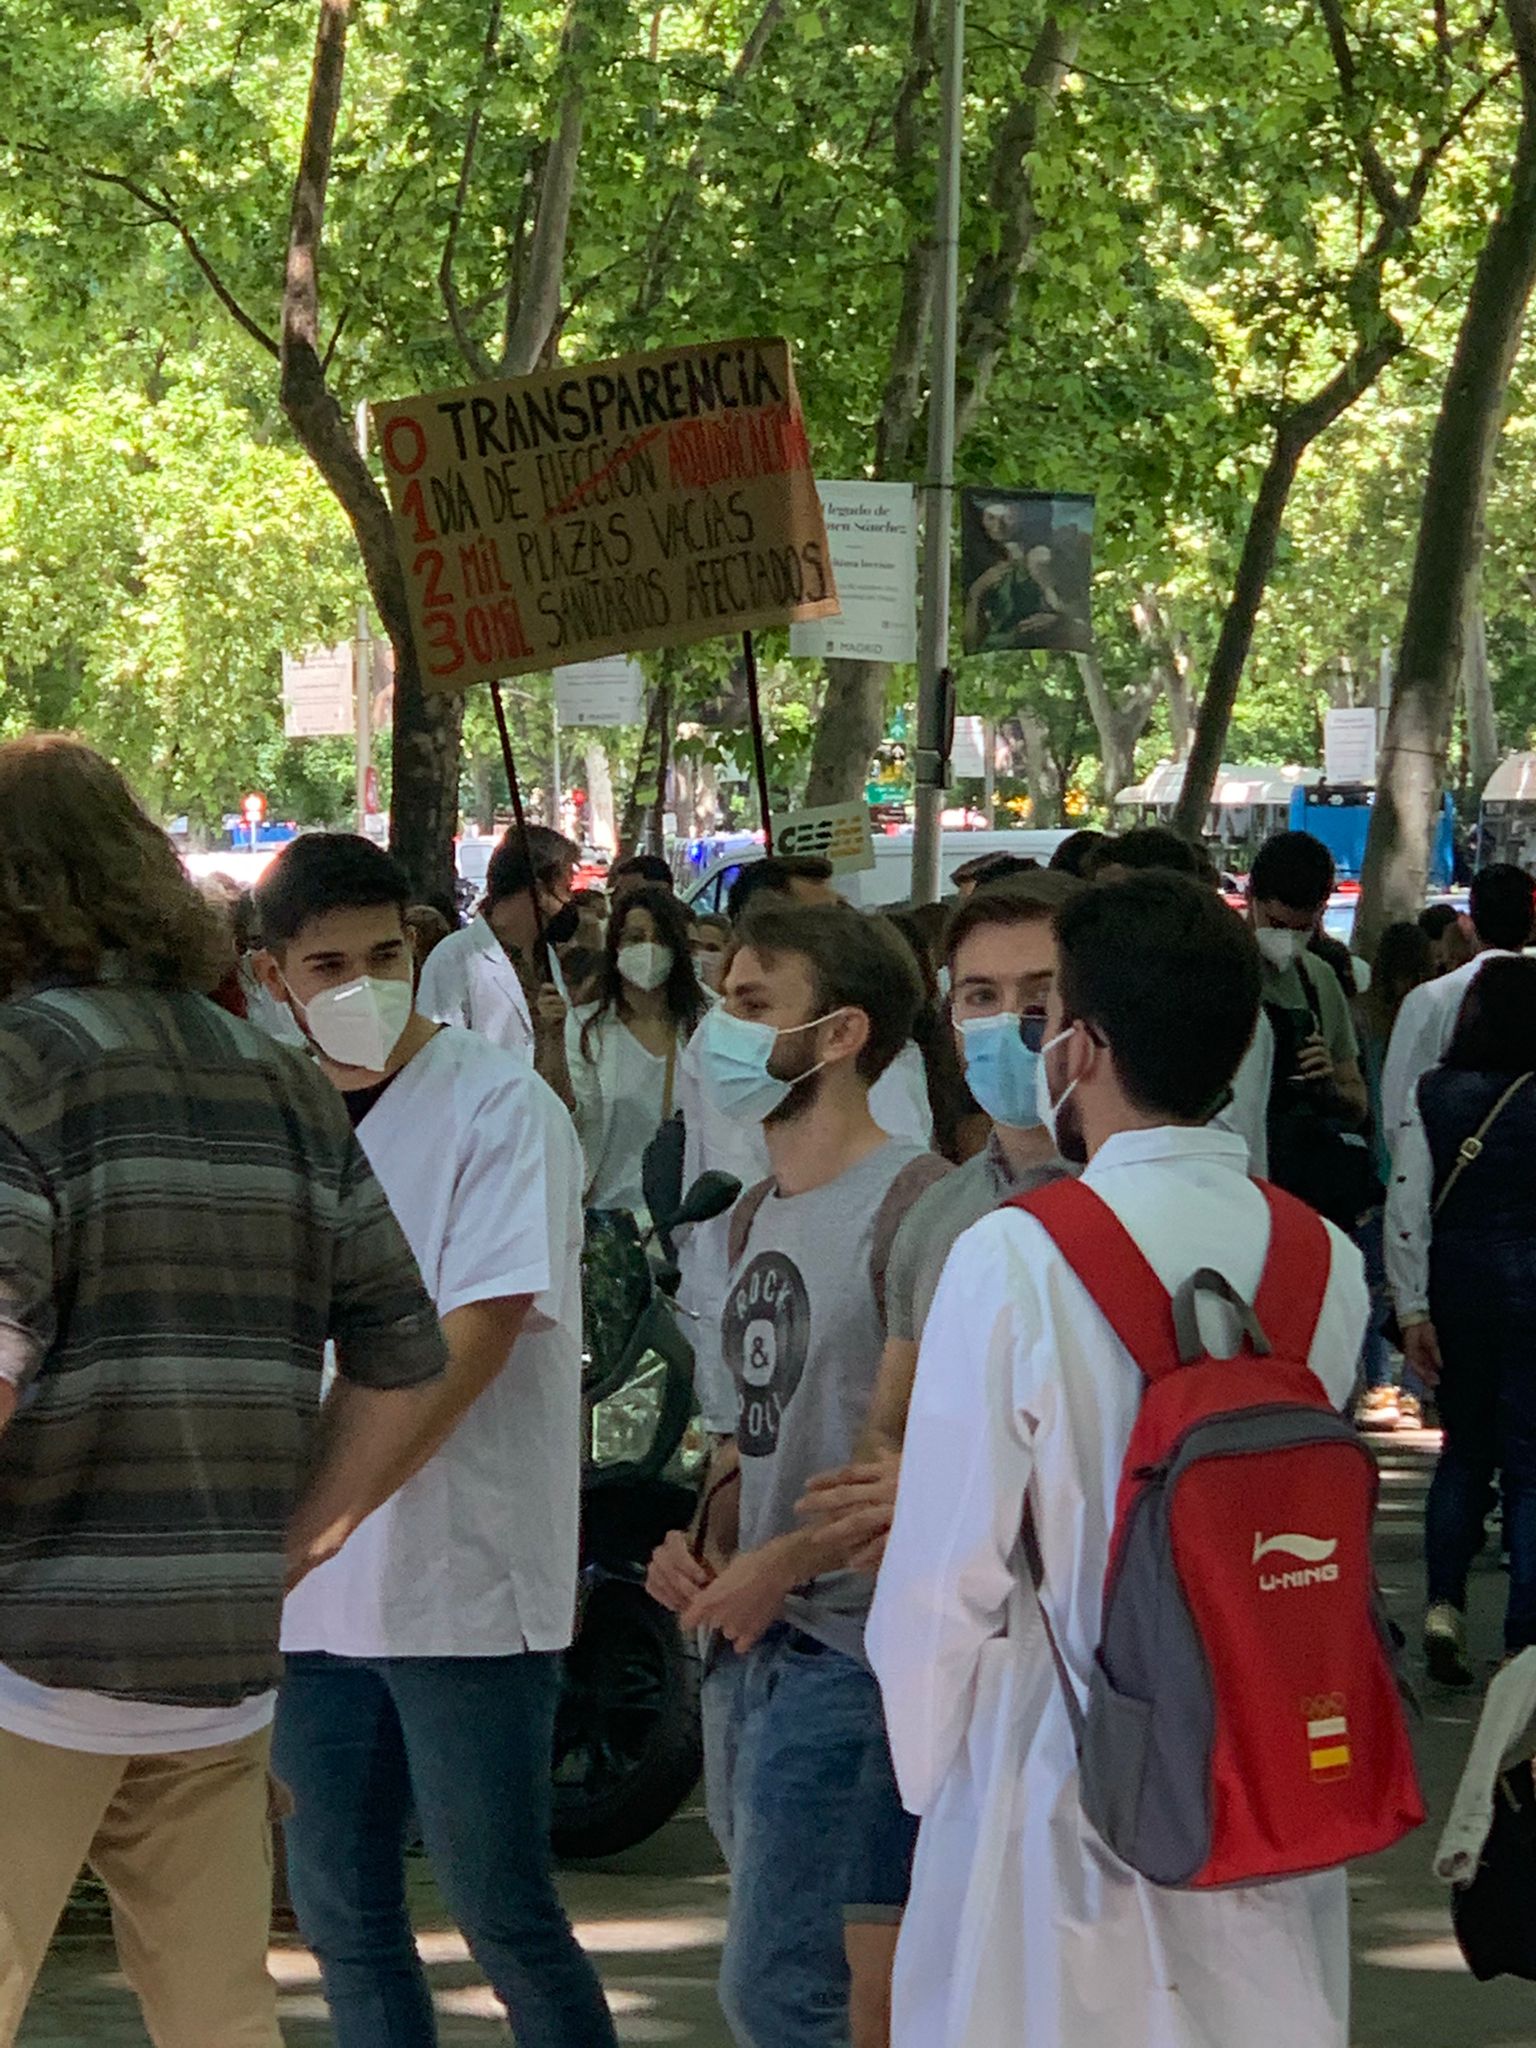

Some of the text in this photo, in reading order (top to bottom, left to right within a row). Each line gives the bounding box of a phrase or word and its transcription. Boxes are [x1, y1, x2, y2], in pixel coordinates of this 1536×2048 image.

[383, 416, 427, 475] 0
[402, 478, 437, 543] 1
[484, 459, 528, 524] DE
[411, 548, 454, 609] 2
[517, 512, 632, 587] PLAZAS
[685, 540, 828, 621] AFECTADOS
[751, 1336, 769, 1368] &
